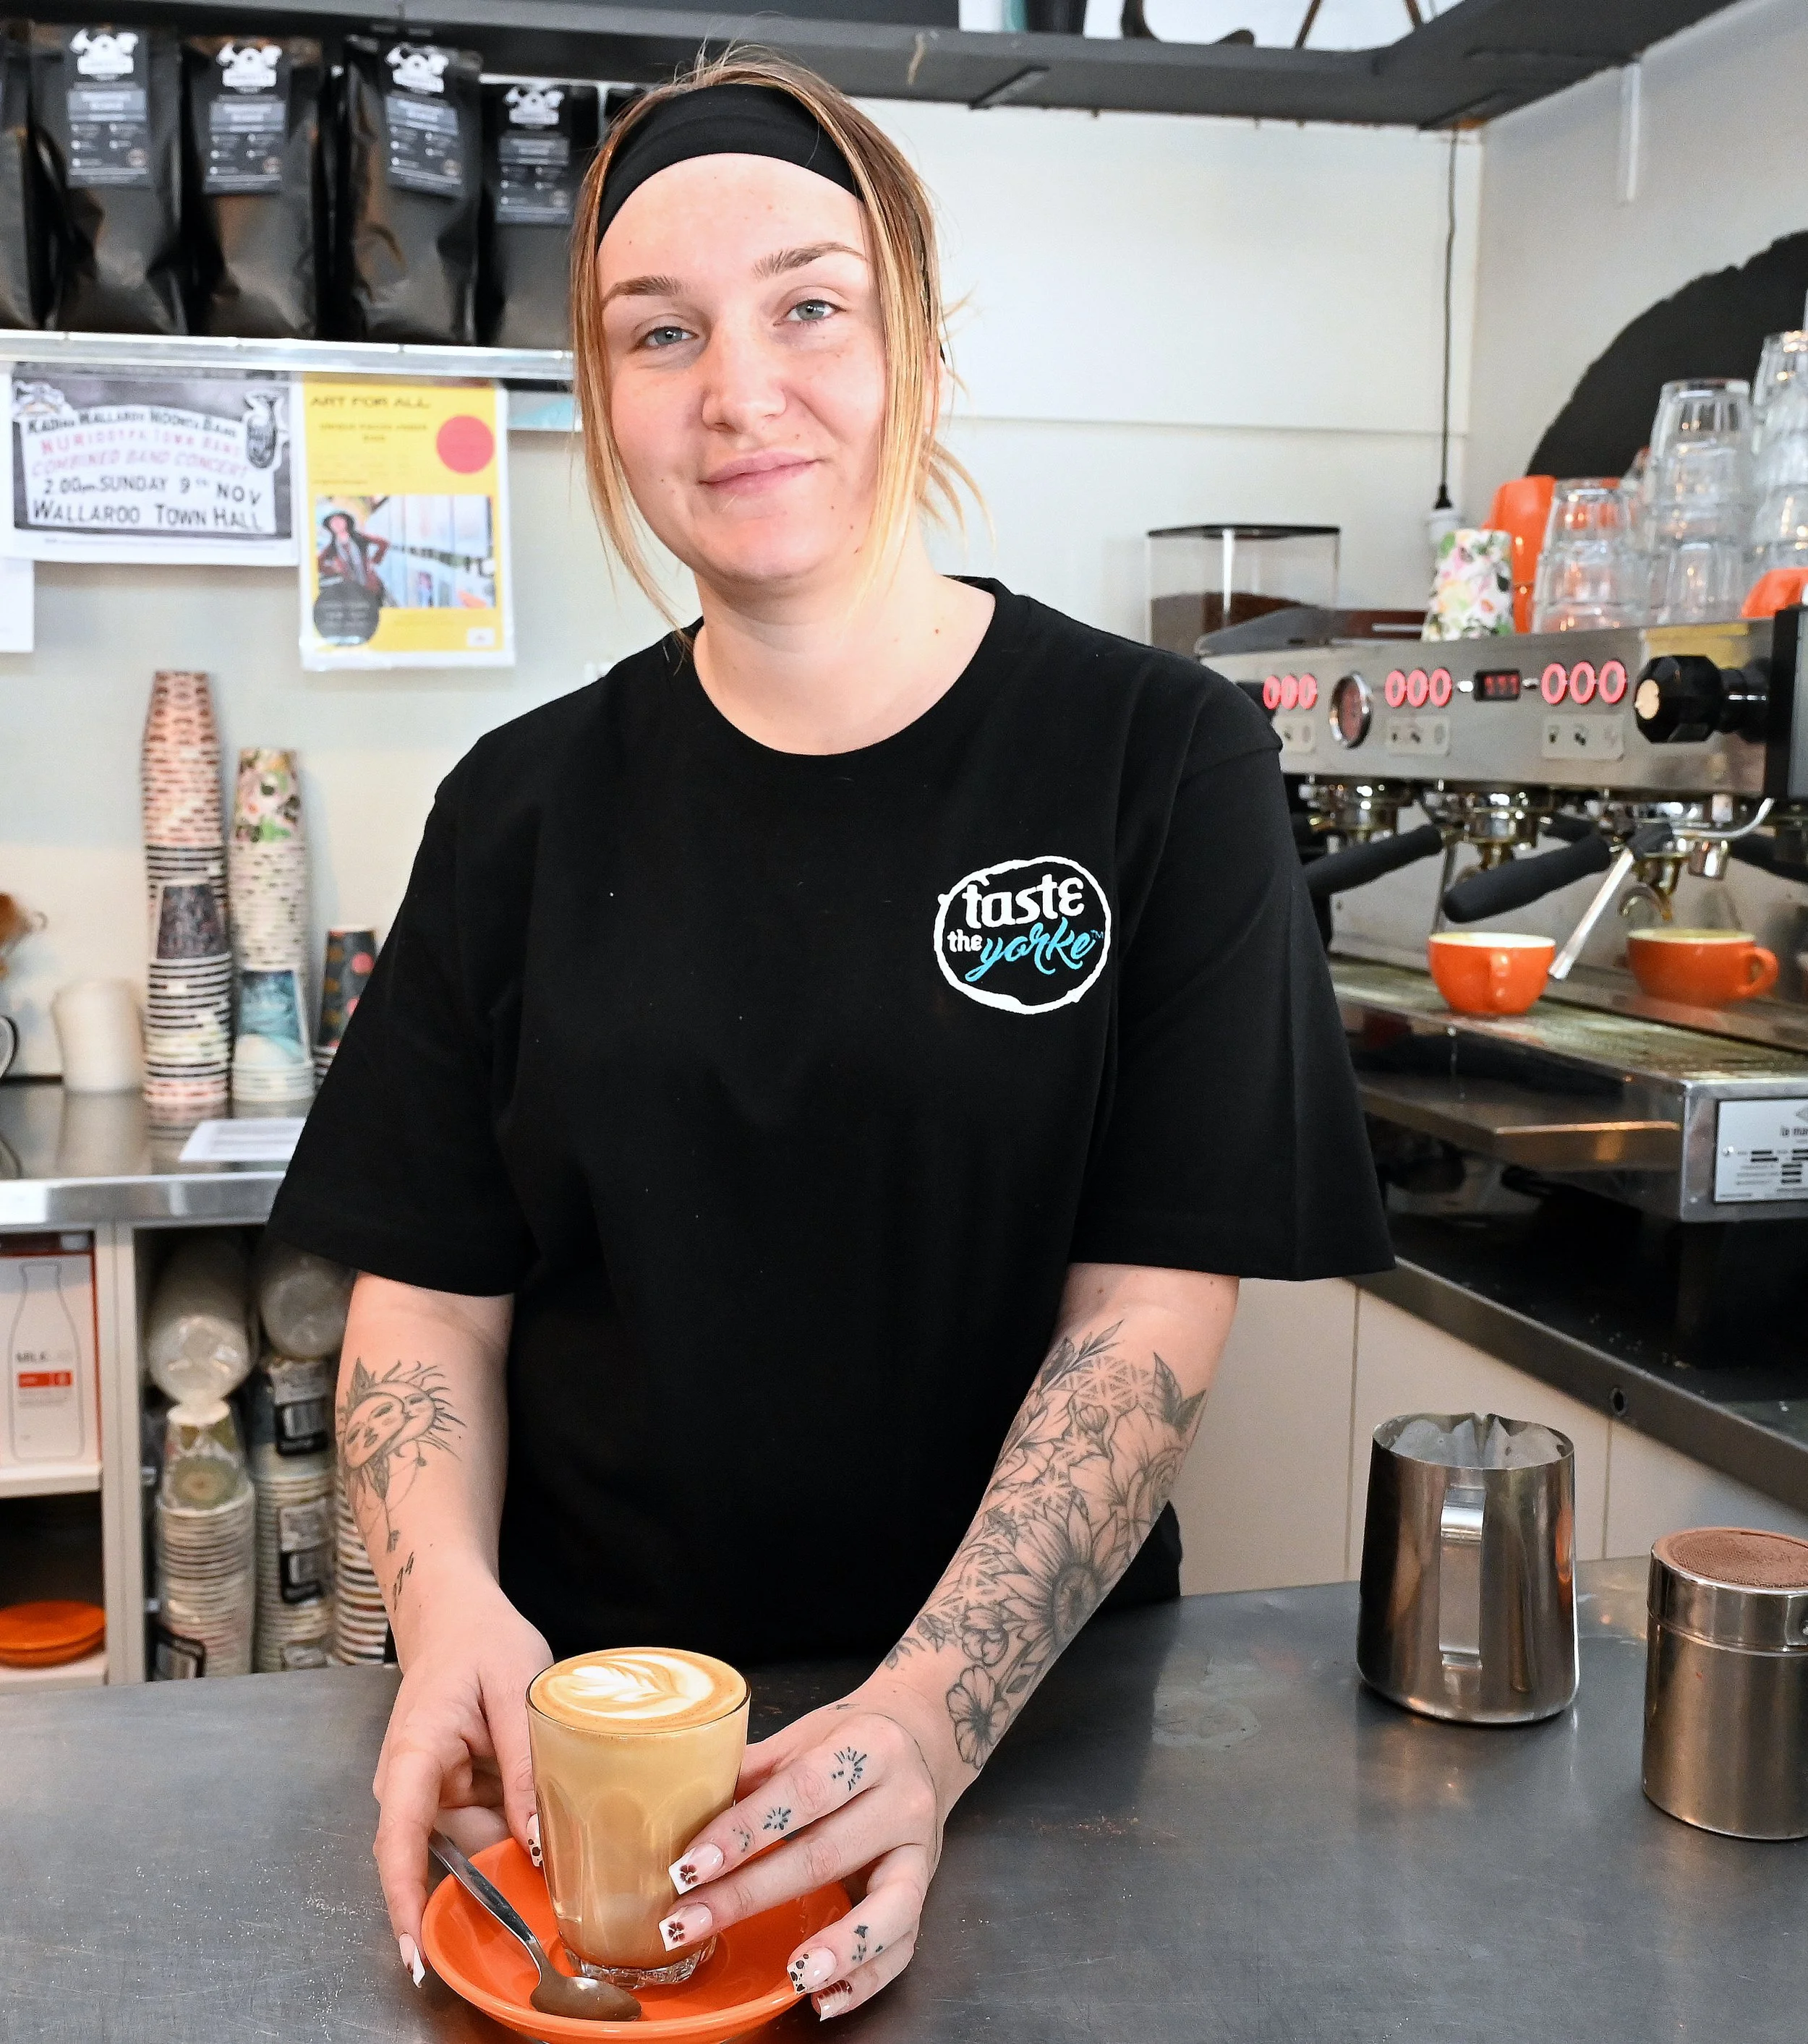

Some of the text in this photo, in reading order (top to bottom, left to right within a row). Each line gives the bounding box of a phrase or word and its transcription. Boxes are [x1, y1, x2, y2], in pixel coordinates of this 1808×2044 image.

[310, 395, 345, 408] ART
[351, 395, 388, 409] FOR
[32, 448, 248, 479] COMBINED BAND CONCERT
[100, 474, 168, 492] SUNDAY
[216, 482, 261, 505] NOV
[33, 499, 263, 531] WALLAROO TOWN HALL
[961, 873, 1085, 928] taste
[947, 929, 983, 952] the
[965, 916, 1096, 983] yorke
